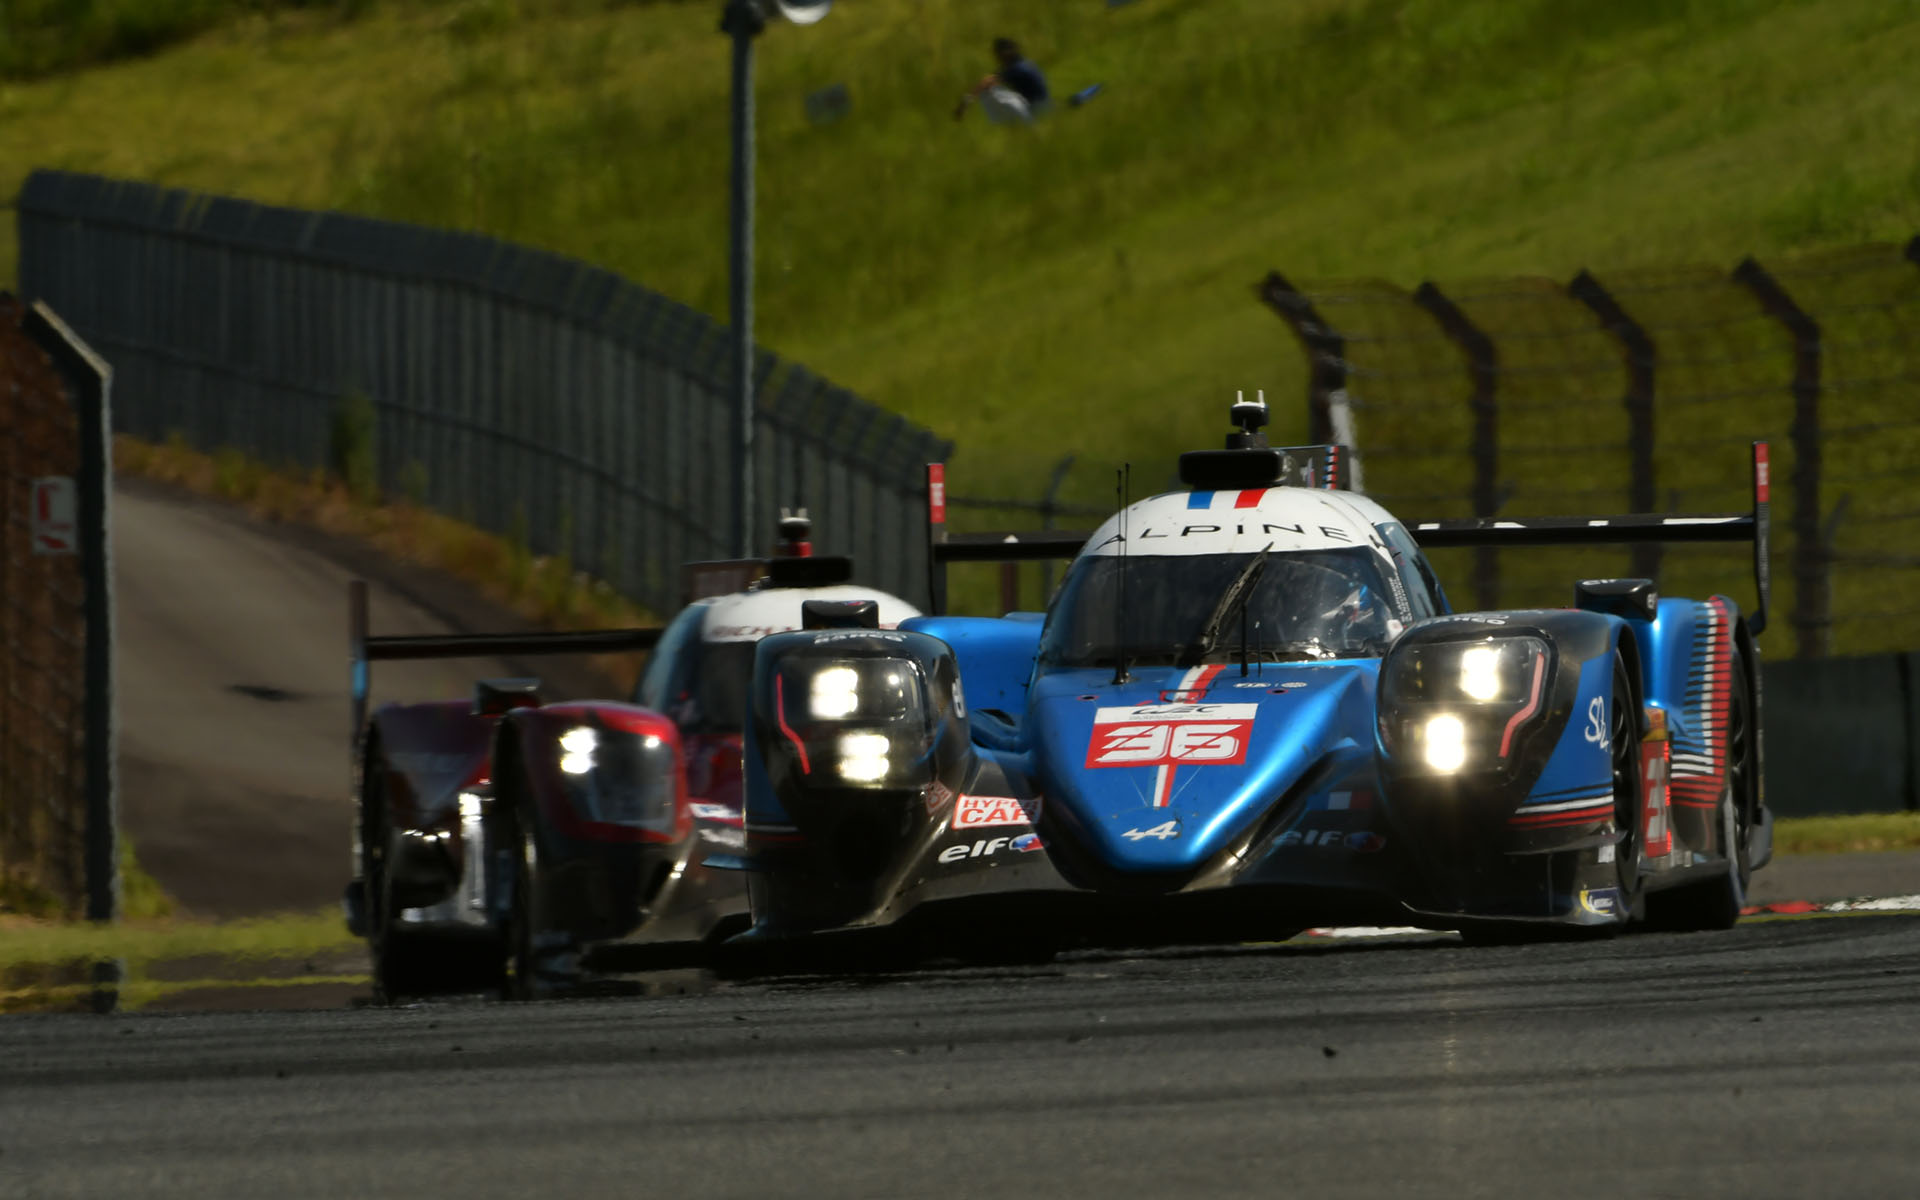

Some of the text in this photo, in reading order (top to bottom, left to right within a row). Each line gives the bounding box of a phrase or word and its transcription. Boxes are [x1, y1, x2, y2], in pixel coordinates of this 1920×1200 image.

[1096, 523, 1353, 550] ALPINE
[1131, 704, 1223, 715] WEC
[1094, 723, 1240, 761] 36
[963, 799, 1039, 809] HYPER
[960, 808, 1034, 824] CAR
[938, 837, 1010, 863] elf
